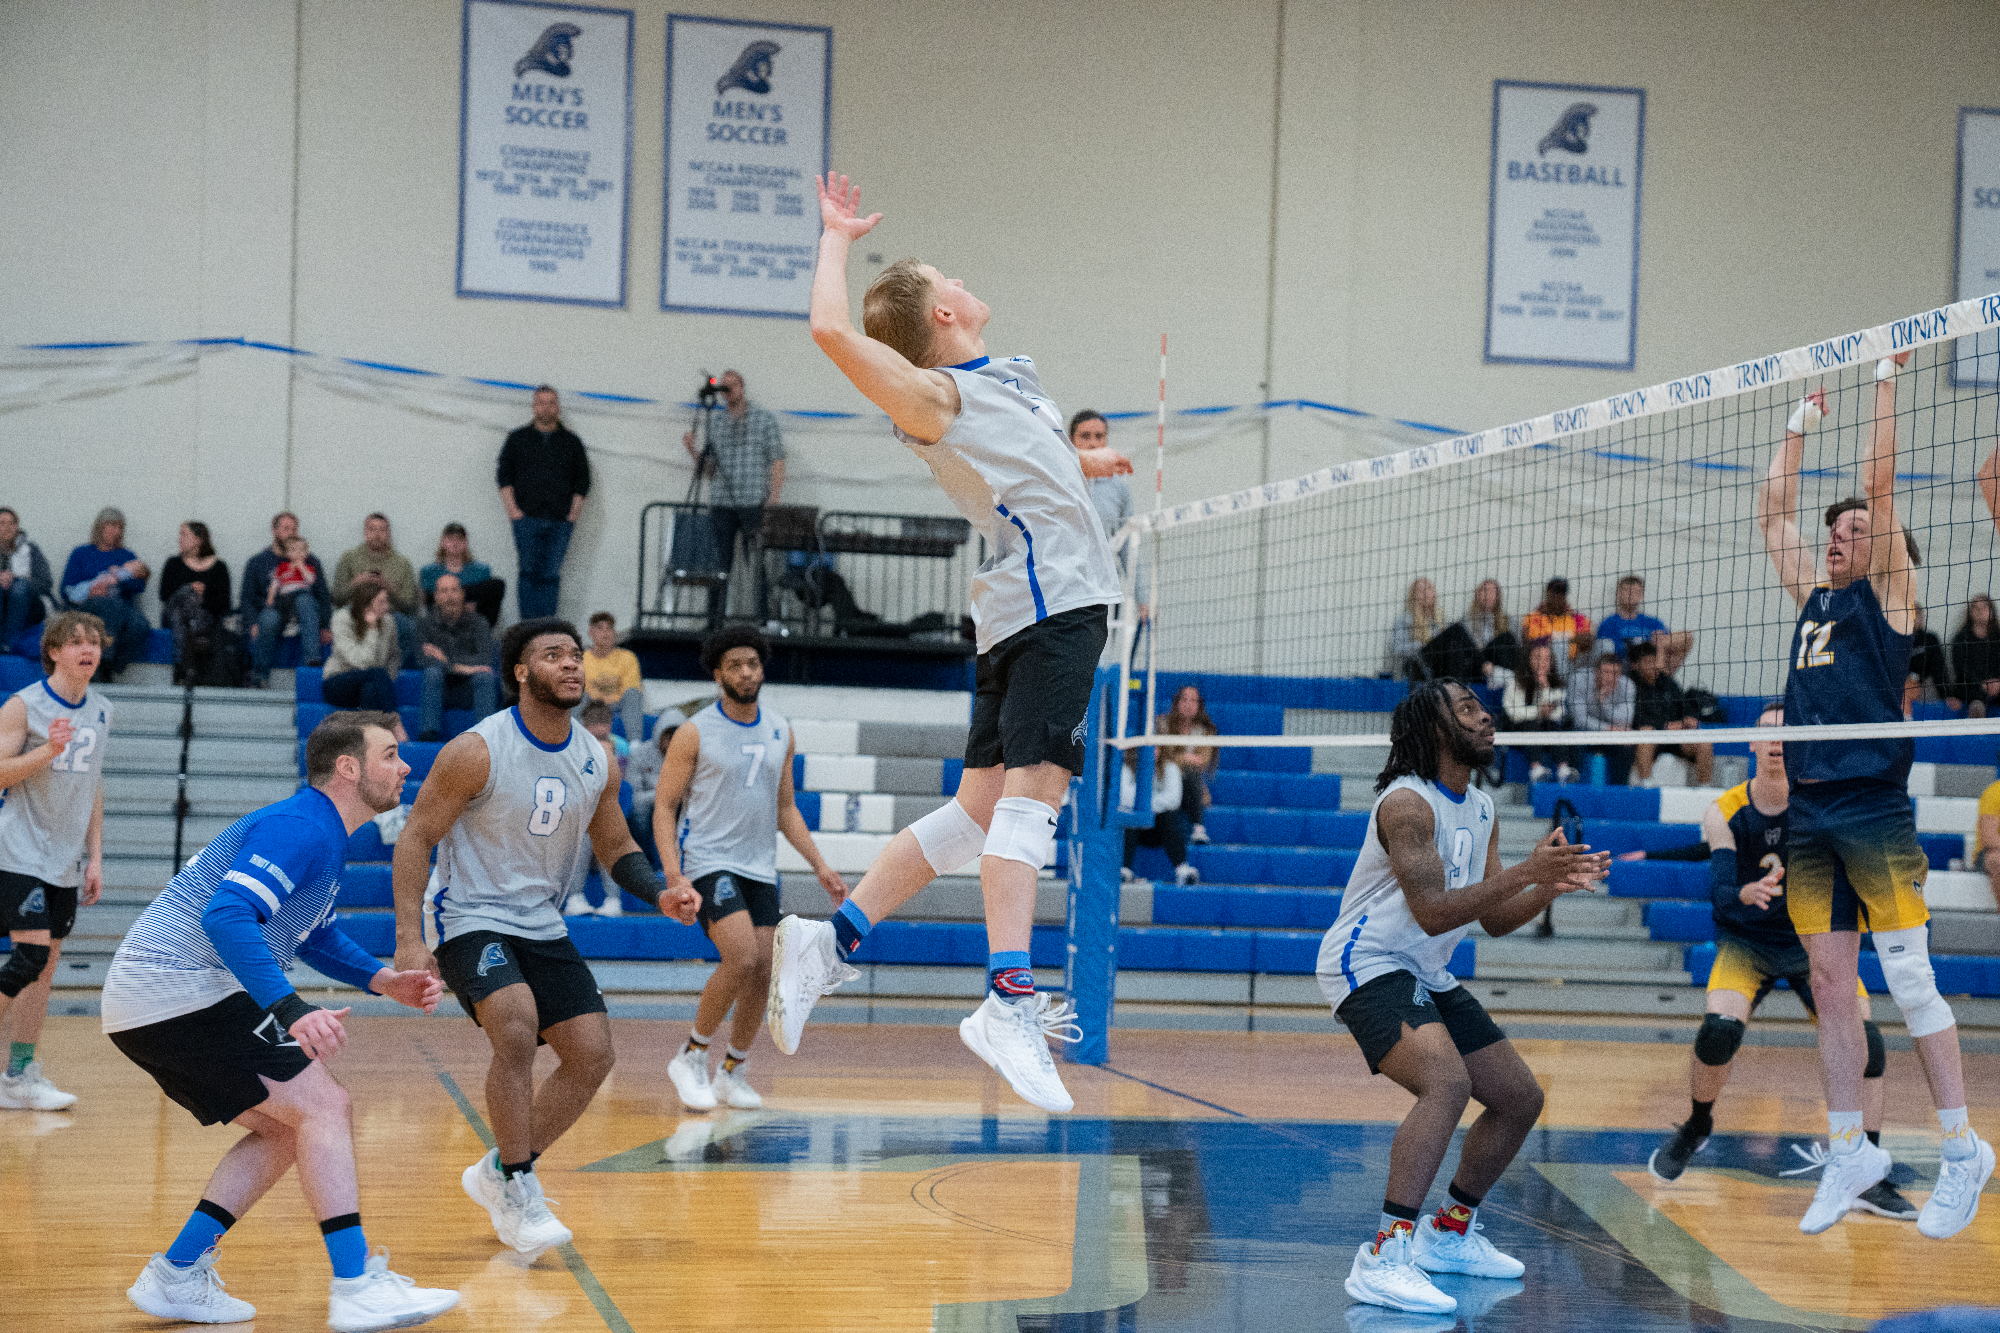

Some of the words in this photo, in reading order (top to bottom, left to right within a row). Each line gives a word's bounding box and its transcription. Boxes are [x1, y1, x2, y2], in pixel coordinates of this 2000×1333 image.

[510, 82, 584, 106] MEN'S
[504, 105, 590, 131] SOCCER
[712, 100, 783, 124] MEN'S
[705, 122, 787, 146] SOCCER
[1507, 160, 1627, 188] BASEBALL
[1973, 186, 2000, 209] SO
[1889, 307, 1949, 349] TRINITY
[1809, 333, 1863, 371] TRINITY
[1796, 620, 1836, 669] 12
[741, 744, 765, 787] 7
[527, 776, 566, 837] 8
[1450, 827, 1474, 889] 9
